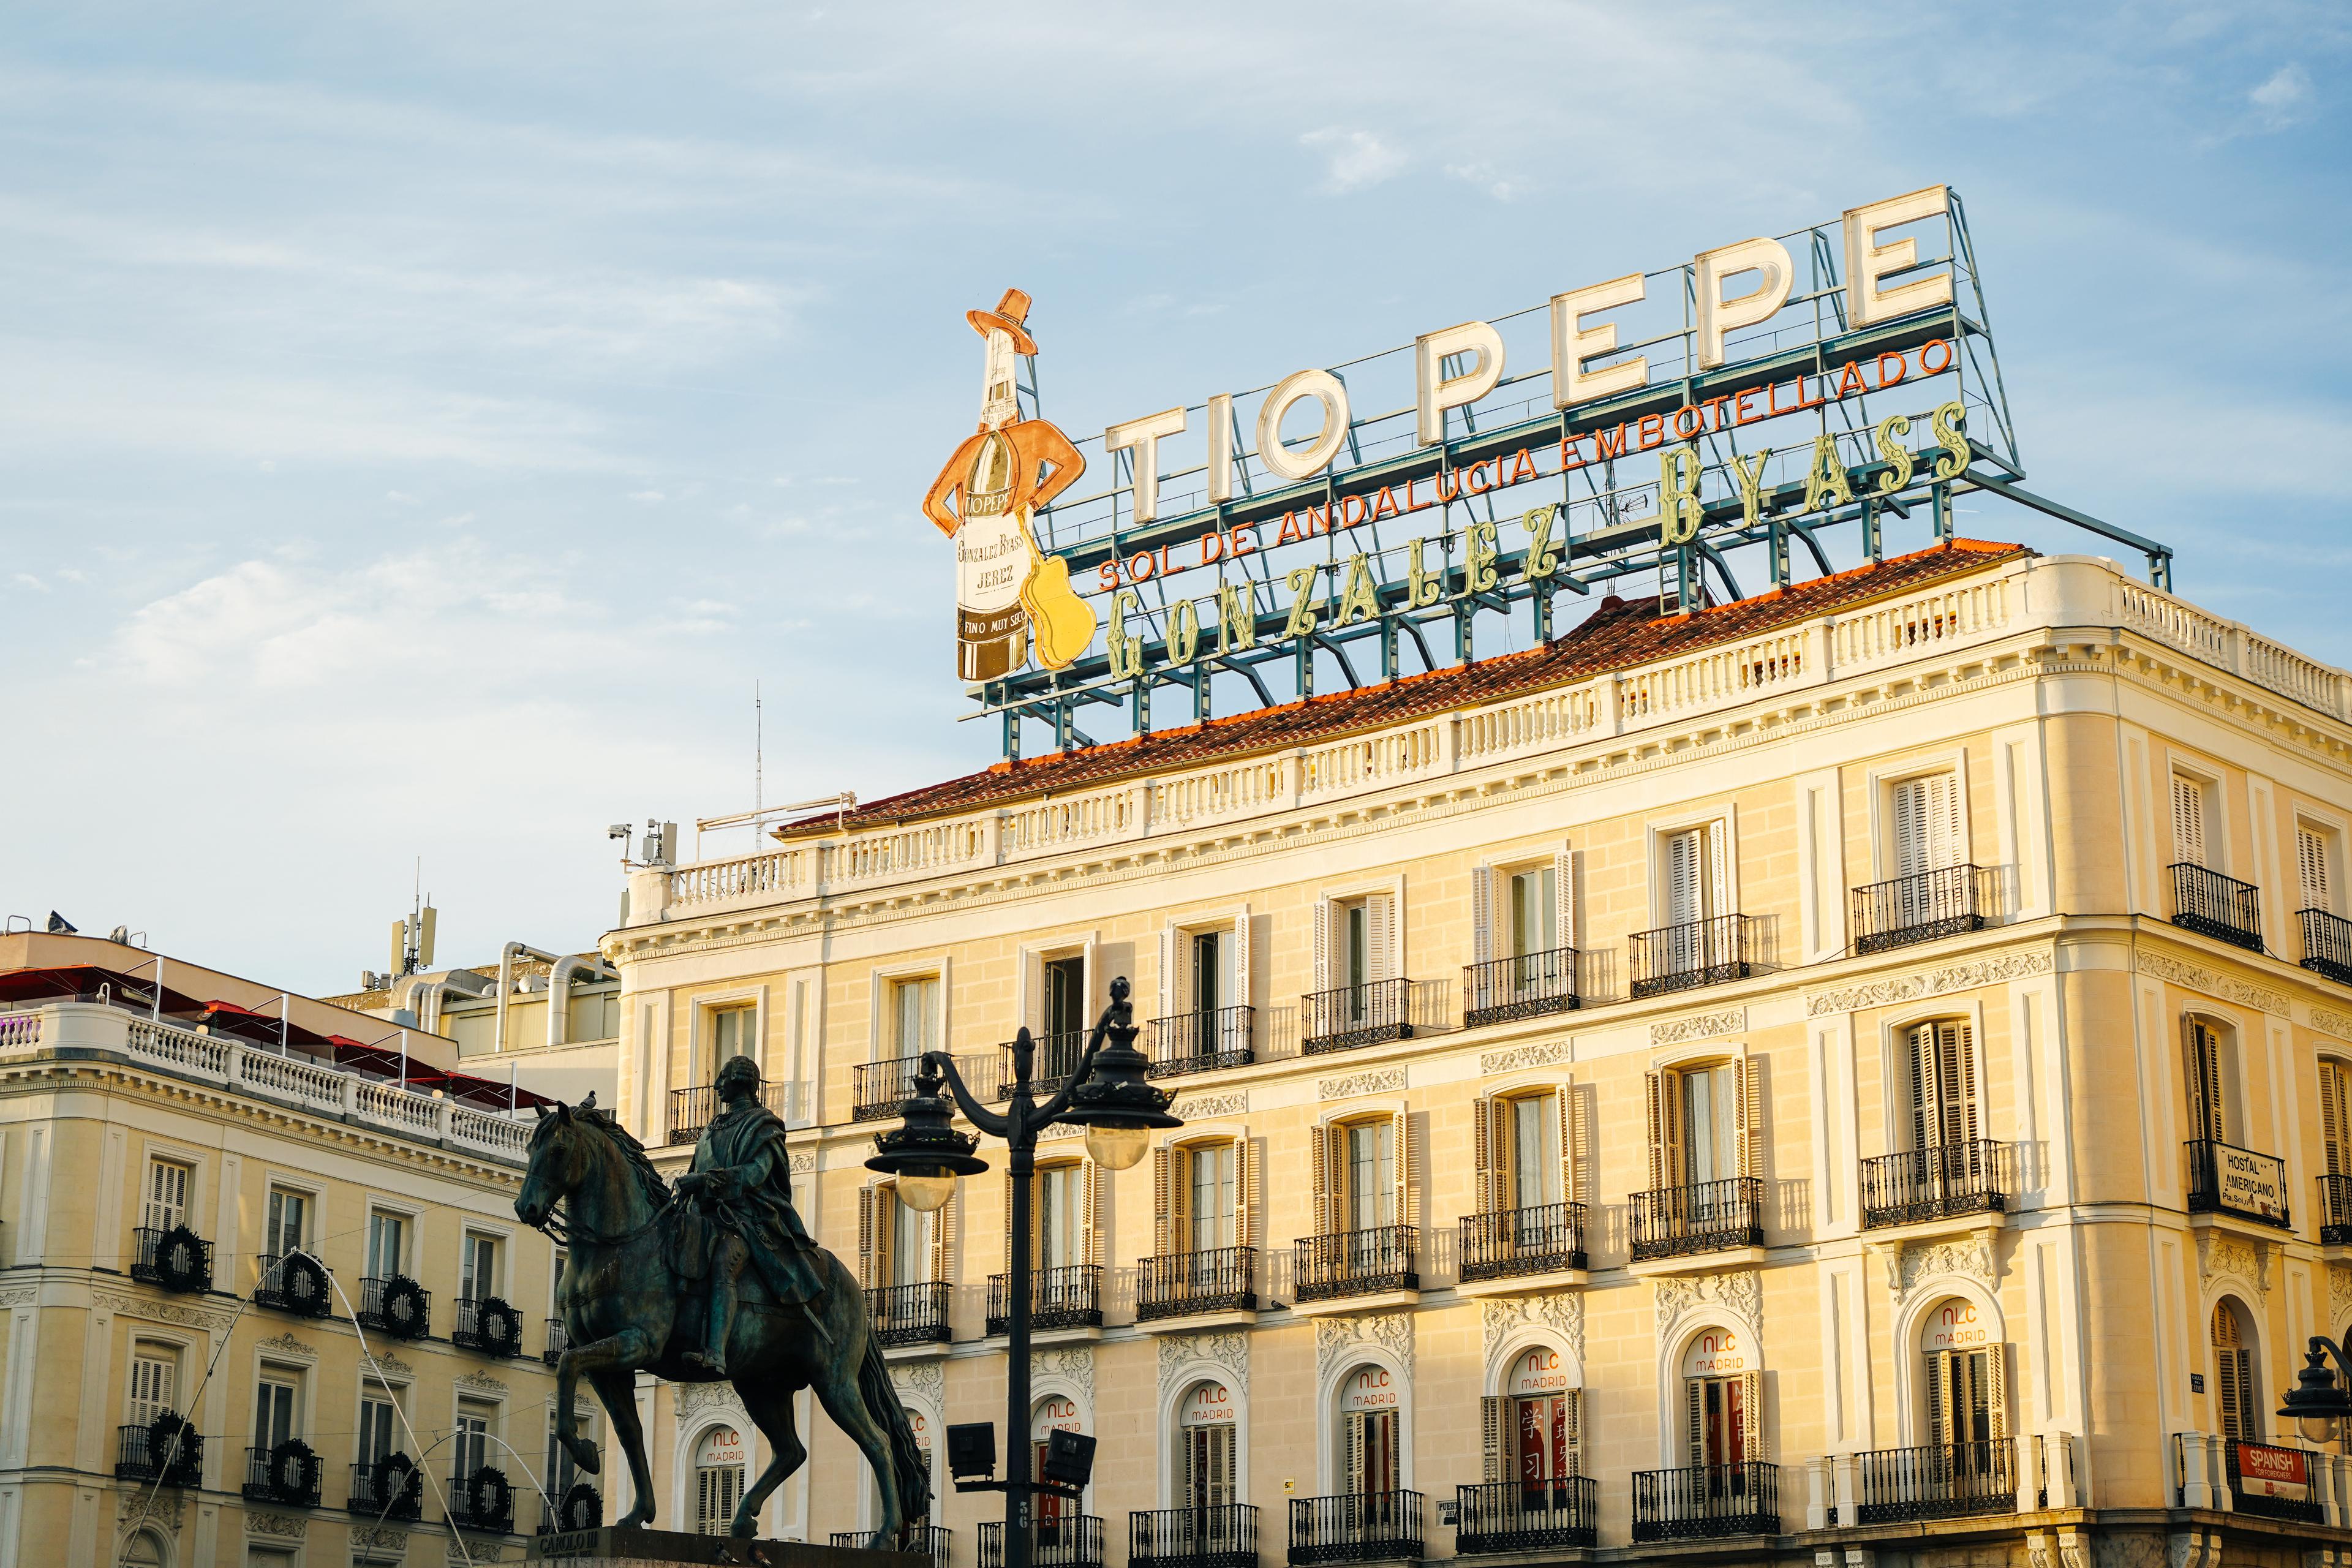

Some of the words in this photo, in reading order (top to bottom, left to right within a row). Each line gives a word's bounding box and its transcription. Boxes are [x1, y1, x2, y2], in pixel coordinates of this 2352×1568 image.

[1105, 369, 1351, 524] TIO
[1417, 183, 1953, 447] PEPE
[1098, 544, 1185, 591] SOL
[1201, 520, 1256, 565] DE
[1276, 448, 1538, 546] ANDALUCIA
[1560, 339, 1953, 472] EMBOTELLADO
[965, 497, 982, 513] TIO
[983, 492, 1009, 513] PEPE
[958, 540, 998, 563] GONZALEZ
[999, 533, 1024, 557] BYASS
[1106, 502, 1560, 679] GONZALEZ
[1659, 401, 1972, 549] BYASS
[977, 565, 1013, 589] JEREZ
[965, 620, 986, 634] FINO
[990, 617, 1008, 632] MUY
[1010, 609, 1027, 626] SECO
[2227, 1154, 2260, 1175] HOSTAL
[2226, 1174, 2274, 1199] AMERICANO
[1935, 1329, 1986, 1346] MADRID
[1696, 1357, 1744, 1372] MADRID
[1521, 1376, 1566, 1390] MADRID
[1353, 1392, 1396, 1406] MADRID
[1192, 1408, 1234, 1422] MADRID
[1521, 1408, 1544, 1480] 学习
[706, 1450, 744, 1463] MADRID
[2250, 1449, 2294, 1472] SPANISH
[2255, 1468, 2264, 1477] FOR
[2264, 1469, 2291, 1480] FOREIGNERS
[540, 1532, 584, 1554] CAROLO
[586, 1530, 598, 1548] III
